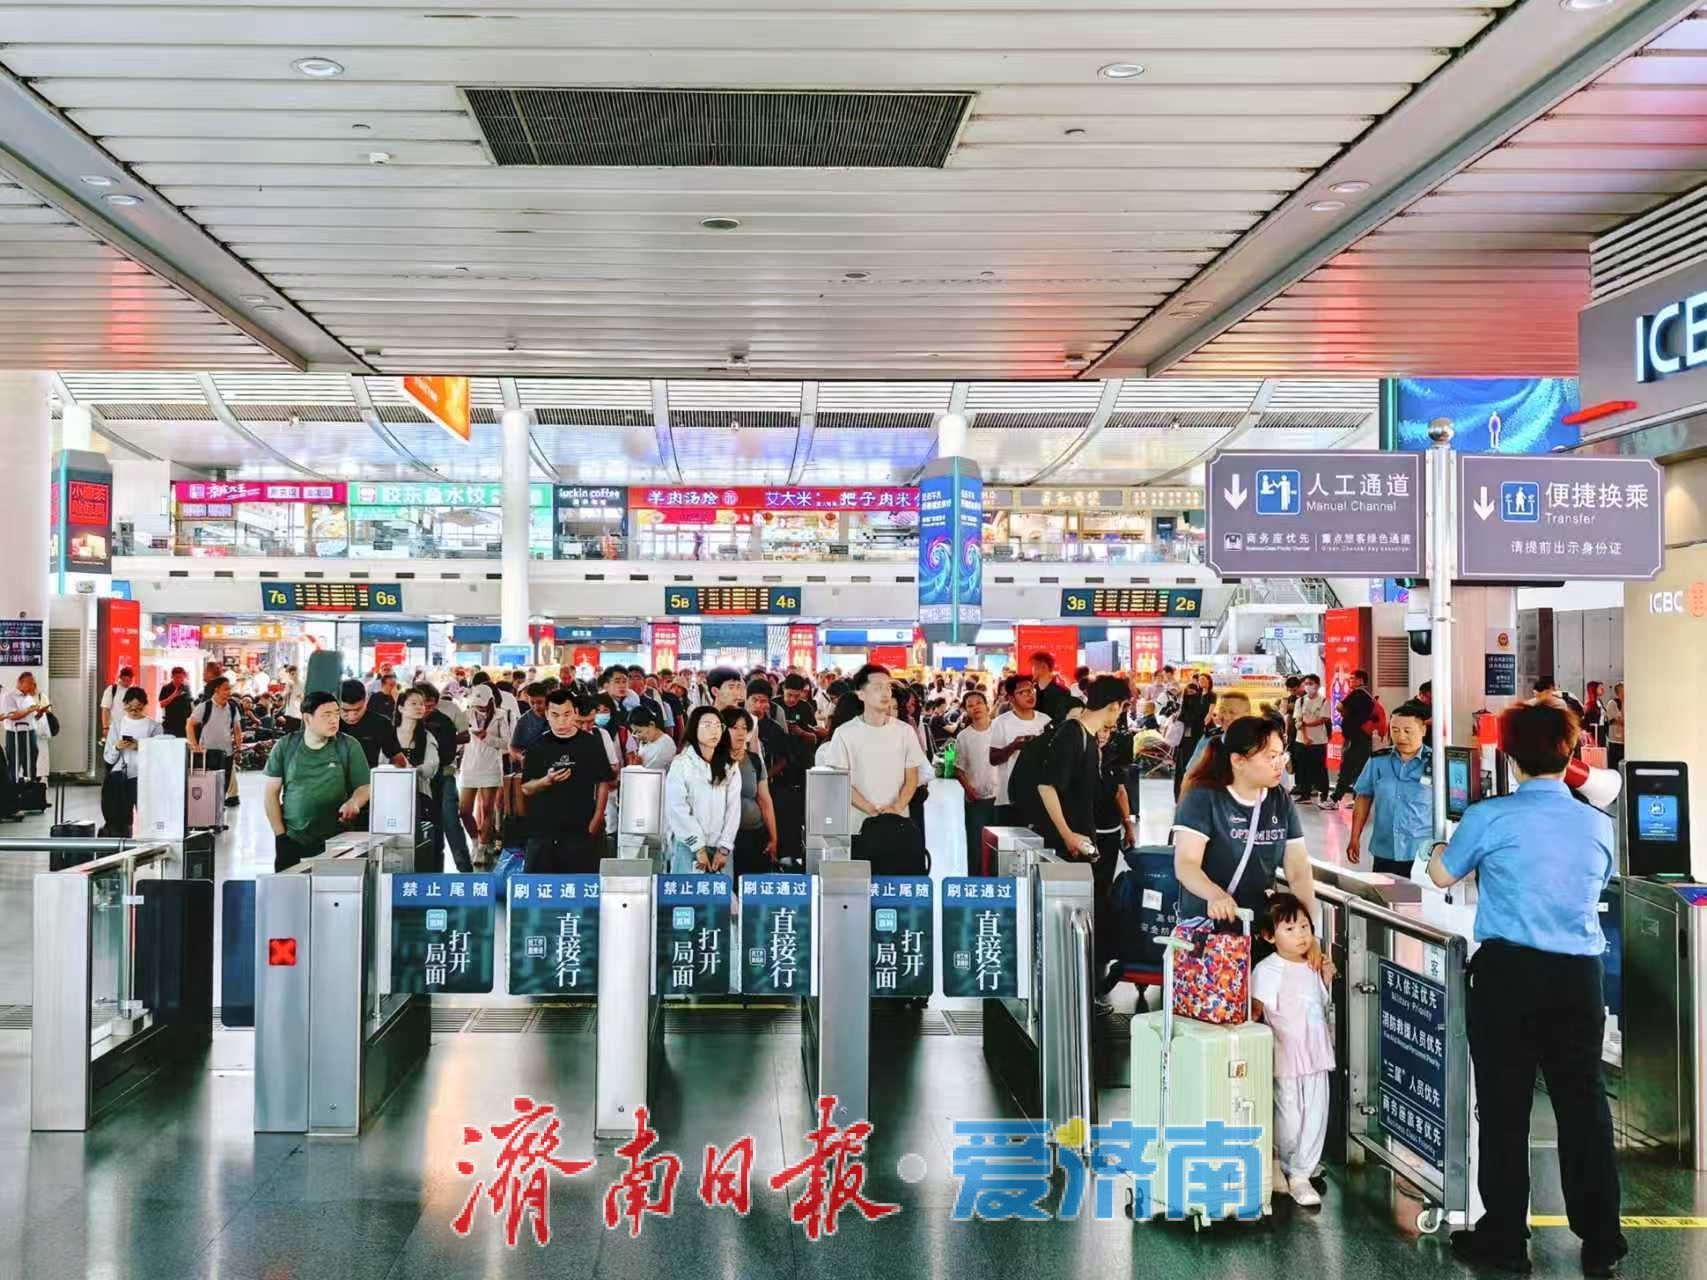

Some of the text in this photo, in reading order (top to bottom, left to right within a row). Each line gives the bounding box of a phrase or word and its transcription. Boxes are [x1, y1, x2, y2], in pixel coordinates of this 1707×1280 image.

[559, 487, 588, 497] luckin
[590, 487, 620, 498] coffee
[1307, 473, 1410, 497] 人工通道
[1545, 482, 1649, 509] 便捷换乘
[1306, 500, 1397, 512] Manual Channel
[1545, 512, 1596, 525] Transfer
[1246, 533, 1310, 544] 商务座优先
[1322, 533, 1411, 545] 重点旅客绿色通道
[1511, 540, 1623, 555] 请提前出示身份证
[268, 590, 287, 604] 7B
[376, 591, 396, 605] 6B
[671, 594, 690, 608] 5B
[776, 595, 796, 608] 4B
[1067, 596, 1086, 610] 3B
[1175, 597, 1196, 610] 2B
[1649, 591, 1683, 614] ICBC
[1230, 828, 1286, 840] OPTMIST
[403, 882, 489, 897] 禁止尾随
[514, 883, 599, 899] 刷证通过
[664, 881, 728, 895] 禁止尾随
[744, 881, 807, 896] 刷证通过
[947, 884, 1012, 898] 刷证通过
[449, 930, 472, 974] 打开
[555, 912, 581, 987] 直接行
[698, 928, 721, 975] 打开
[770, 908, 797, 988] 直接行
[901, 930, 924, 977] 打开
[975, 910, 1002, 991] 直接行
[425, 943, 446, 985] 局面
[672, 941, 694, 987] 局面
[875, 943, 897, 989] 局面
[1386, 969, 1436, 1010] 军人依法优先
[1382, 1009, 1442, 1059] 消防救援人员优先
[1383, 1093, 1440, 1148] 商务座旅客优先
